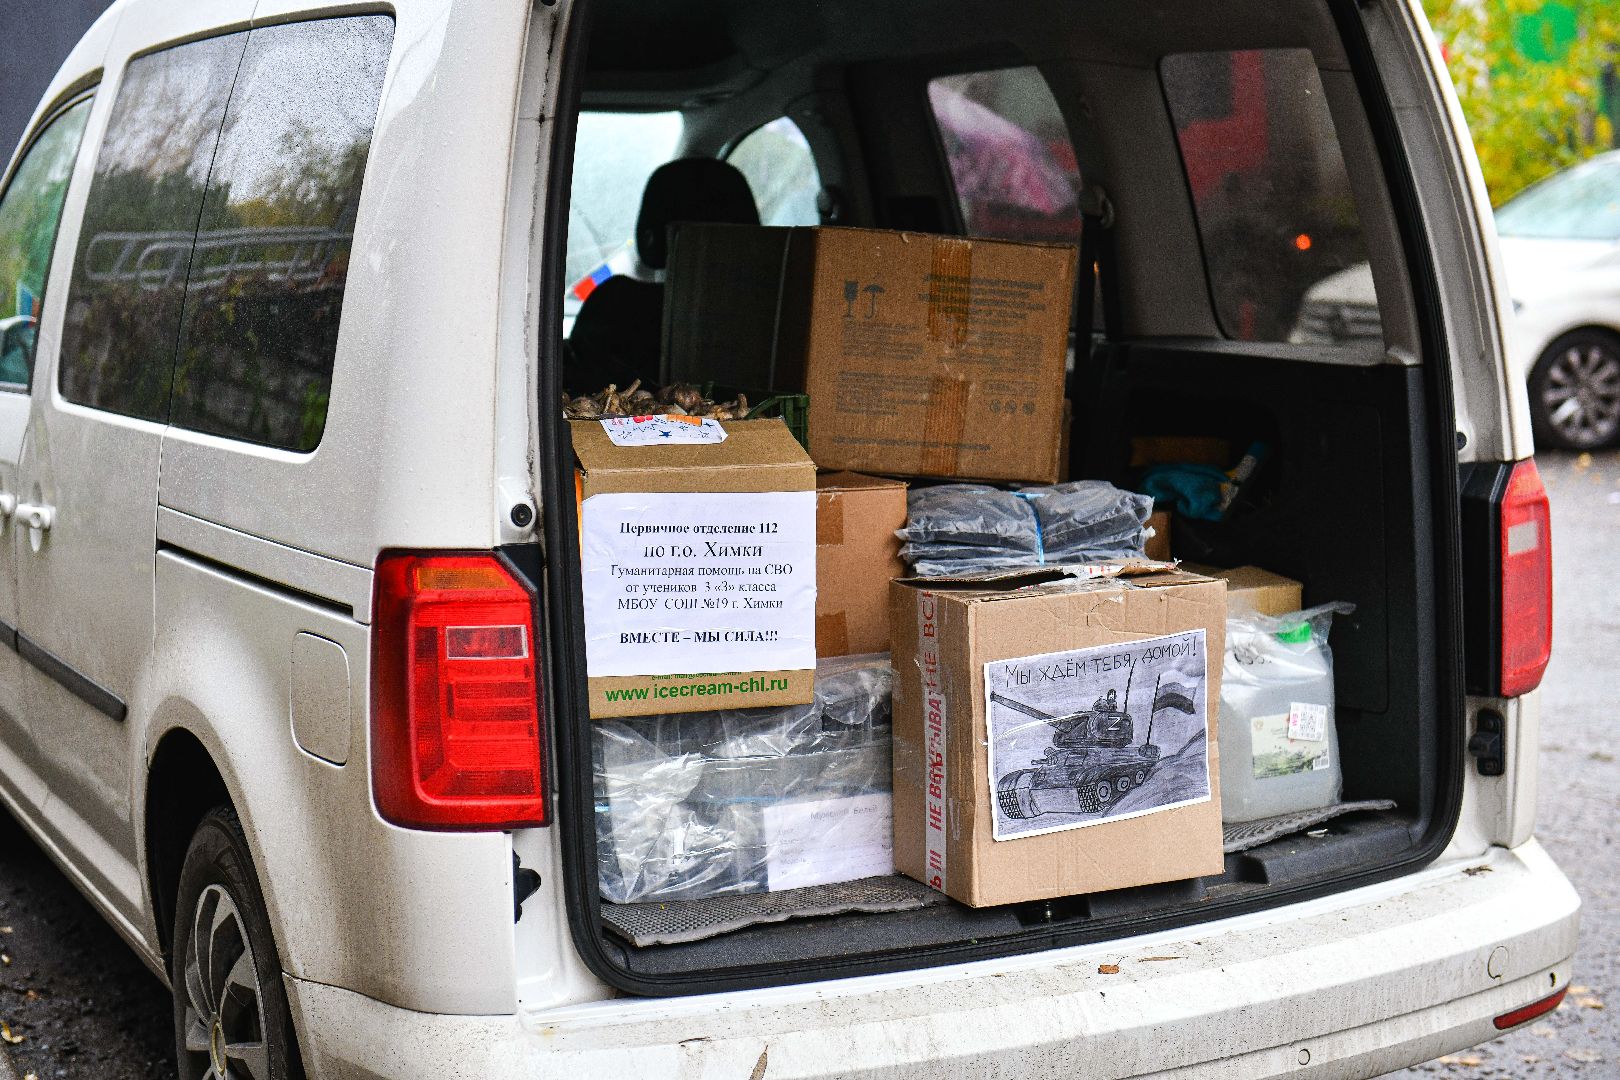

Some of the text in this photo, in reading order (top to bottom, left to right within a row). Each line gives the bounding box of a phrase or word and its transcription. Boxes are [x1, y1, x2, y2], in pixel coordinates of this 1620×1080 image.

[620, 522, 778, 536] Первичное отделение 112
[704, 541, 763, 557] Химки
[611, 563, 793, 579] Гуманитарная помощь на СВО
[625, 584, 640, 593] от
[643, 584, 697, 596] учеников
[705, 581, 711, 592] 3
[738, 583, 777, 592] класса
[617, 598, 658, 610] МБОУ
[664, 598, 698, 610] СОШ
[701, 597, 729, 609] №19
[743, 597, 783, 609] Химки
[620, 632, 680, 644] ВМЕСТЕ
[694, 631, 720, 642] МЫ
[724, 630, 778, 642] СИЛА!!!
[1039, 657, 1087, 682] ЖДЁМ
[929, 801, 942, 832] НЕ
